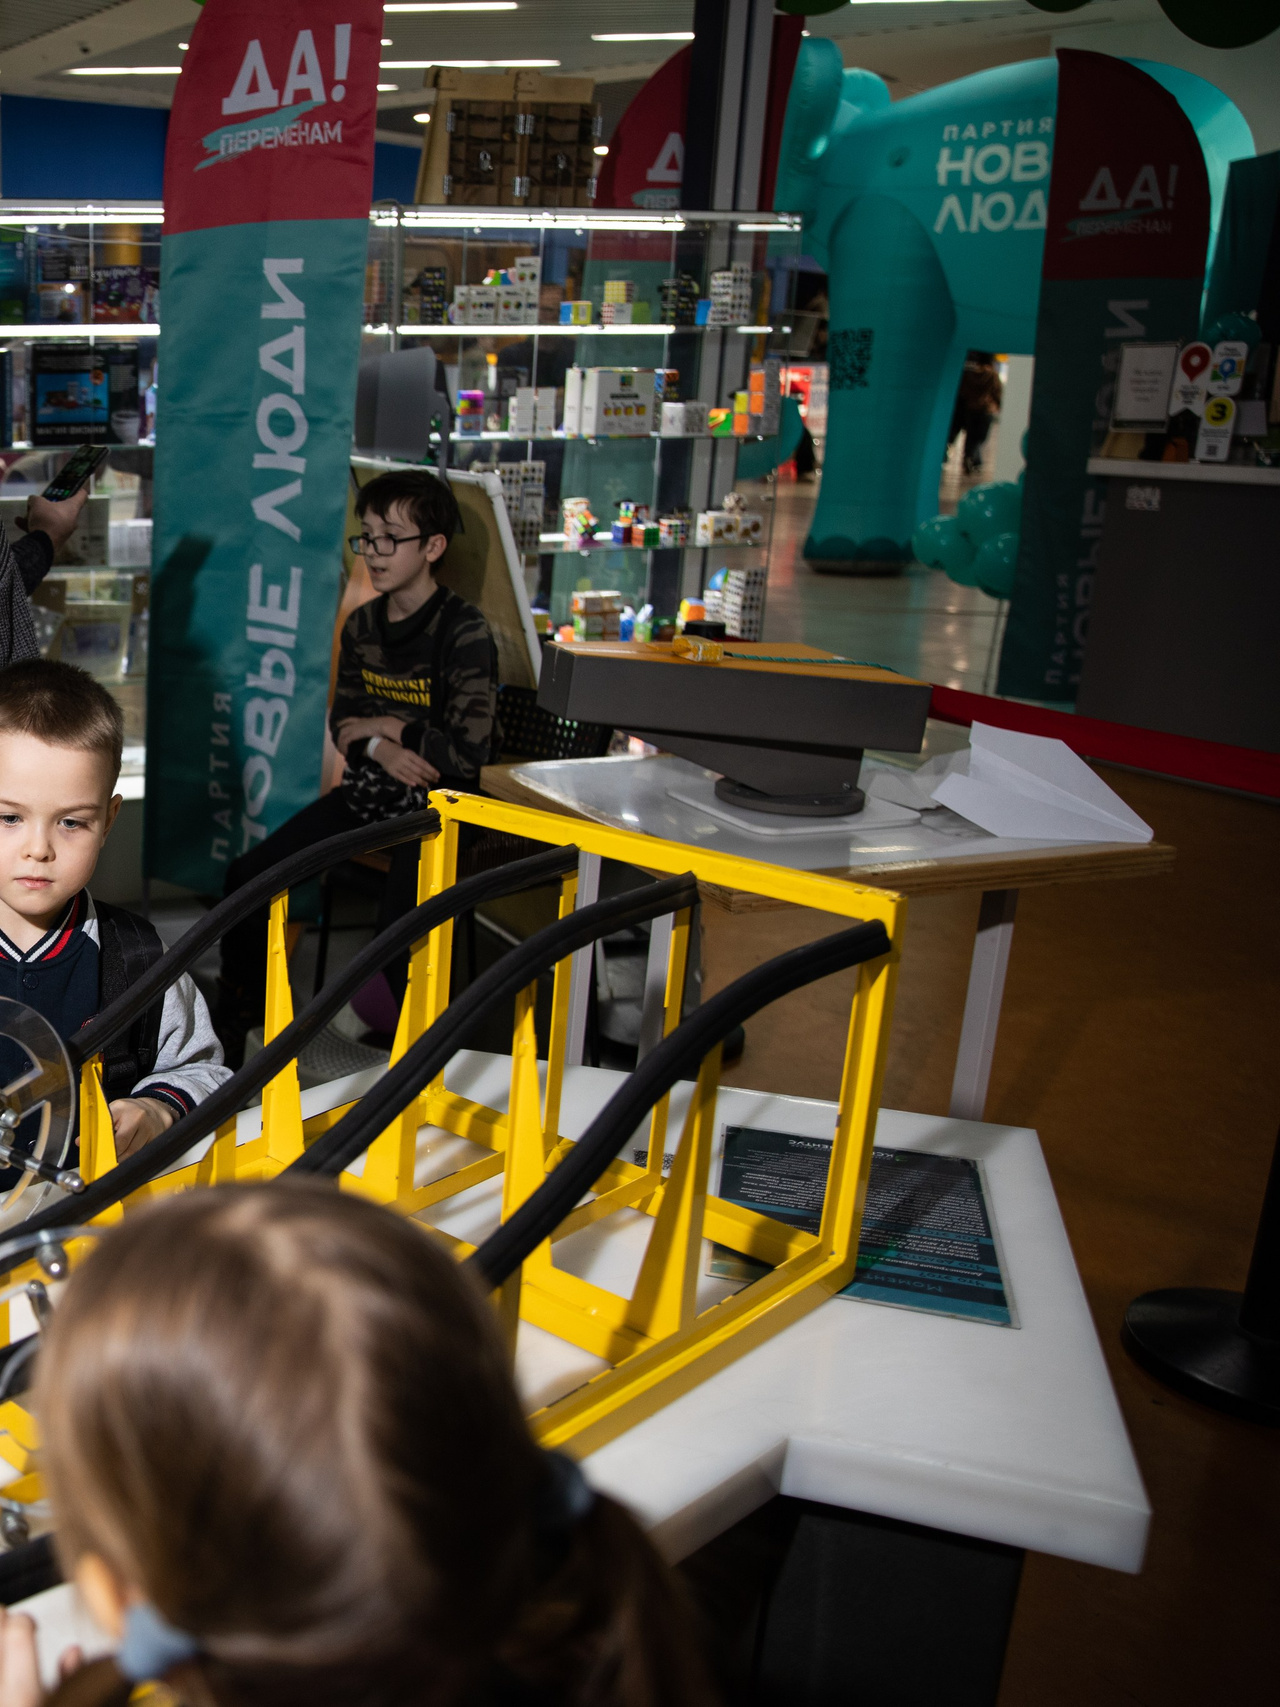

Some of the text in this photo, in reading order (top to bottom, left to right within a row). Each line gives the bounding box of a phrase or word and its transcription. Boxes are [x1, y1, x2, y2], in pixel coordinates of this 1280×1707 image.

[222, 22, 352, 116] ДА!
[217, 119, 343, 157] ПЕРЕМЕНАМ
[942, 116, 1054, 143] ПАРТИЯ
[936, 140, 1051, 187] НОВ
[1078, 164, 1179, 211] ДА!
[933, 188, 1049, 235] ЛЮД
[250, 257, 310, 543] ЛЮДИ
[1211, 402, 1226, 421] 3
[1044, 572, 1070, 685] ПАРТИЯ
[364, 684, 432, 708] HANDSOM
[209, 690, 235, 861] ПАРТИЯ
[861, 1219, 921, 1233] работае
[863, 1272, 943, 1292] Момент
